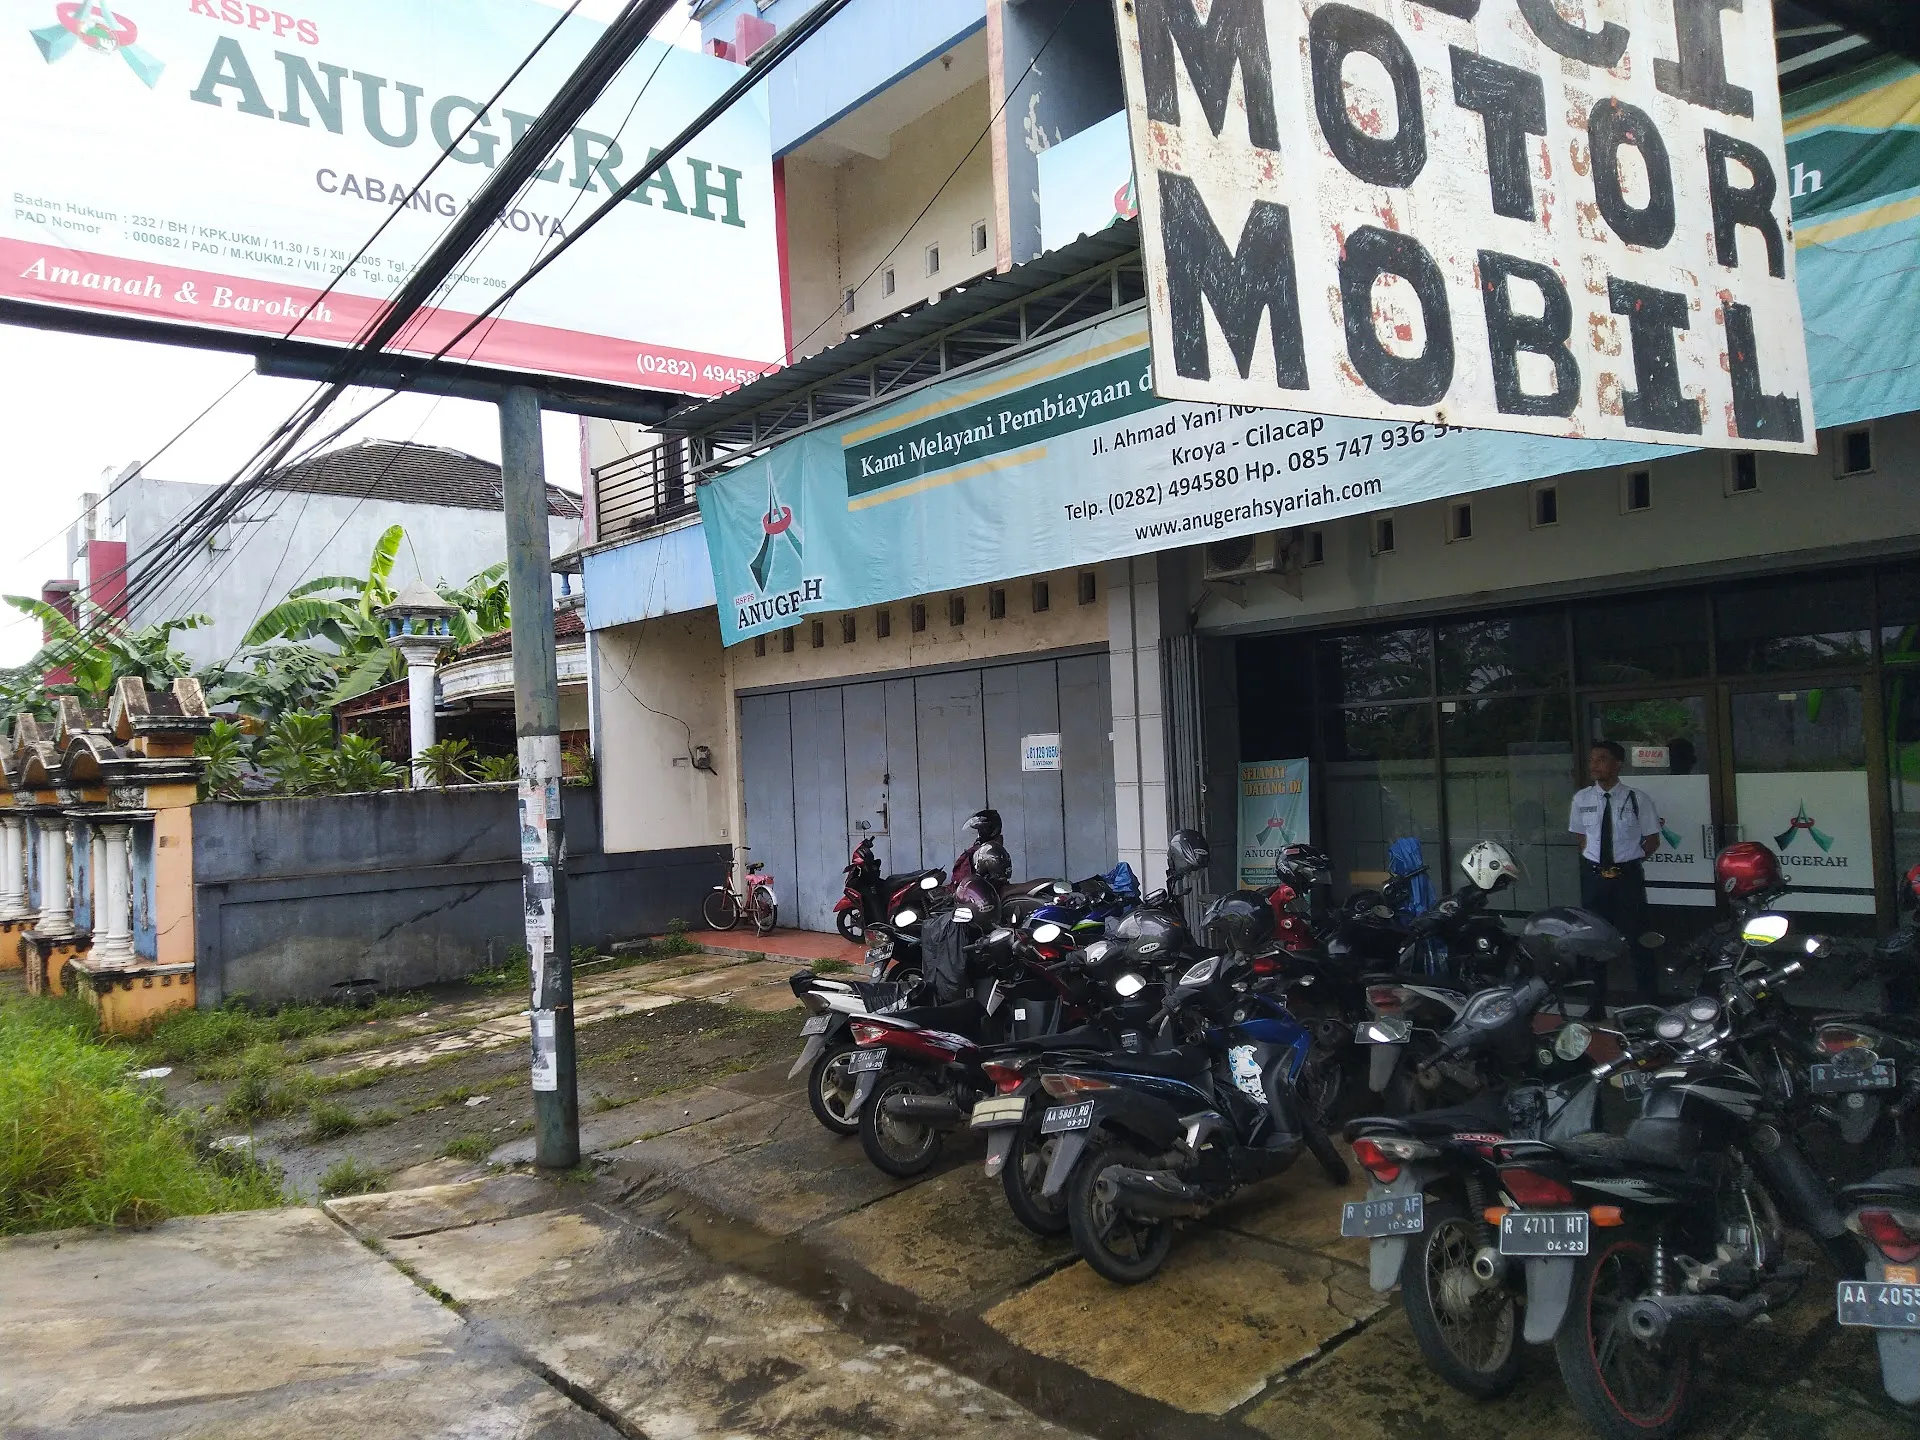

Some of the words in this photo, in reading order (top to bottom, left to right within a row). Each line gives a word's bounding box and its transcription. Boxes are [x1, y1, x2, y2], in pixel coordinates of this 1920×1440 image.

[189, 0, 319, 45] KSPPS
[1134, 0, 1786, 278] MOTOR
[316, 168, 456, 216] CABANG
[468, 198, 568, 240] ROYA
[14, 192, 62, 211] Badan
[66, 203, 117, 222] Hukum
[132, 215, 156, 229] 232
[168, 221, 187, 234] BH
[199, 226, 261, 247] KPK.UKM
[272, 240, 302, 253] 11.30
[483, 277, 507, 289] 2005
[15, 210, 46, 225] PAD
[52, 216, 101, 234] Nomor
[133, 231, 180, 248] 000682
[192, 241, 219, 255] PAD
[19, 257, 163, 299] Amanah
[174, 281, 199, 305] &
[210, 285, 333, 323] Barokah
[1158, 169, 1805, 443] MOBIL
[636, 353, 697, 382] (0282)
[702, 364, 761, 387] 49458
[861, 446, 905, 477] Kami
[909, 417, 995, 456] Melayani
[999, 380, 1132, 435] Pembiayaan
[1092, 436, 1108, 455] Jl.
[1114, 416, 1176, 450] Ahmad
[1181, 404, 1222, 431] Yani
[1172, 440, 1226, 466] Kroya
[1245, 415, 1324, 447] Cilacap
[1064, 500, 1103, 521] Telp.
[1108, 483, 1163, 515] (0282)
[1168, 466, 1239, 498] 494580
[1246, 461, 1281, 482] Hp.
[1288, 446, 1329, 472] 085
[1336, 434, 1373, 462] 747
[1381, 422, 1425, 450] 936
[1135, 476, 1382, 540] www.anugerahsyariah.com
[1242, 766, 1286, 780] SELAMAT
[1638, 750, 1663, 758] BUKA
[1244, 781, 1286, 796] DATANG
[1776, 855, 1848, 867] UGERAH
[1346, 1206, 1354, 1219] R
[1404, 1198, 1420, 1214] AF
[1505, 1218, 1513, 1234] R
[1524, 1217, 1555, 1234] 4711
[1566, 1217, 1583, 1233] HT
[1843, 1285, 1867, 1303] AA
